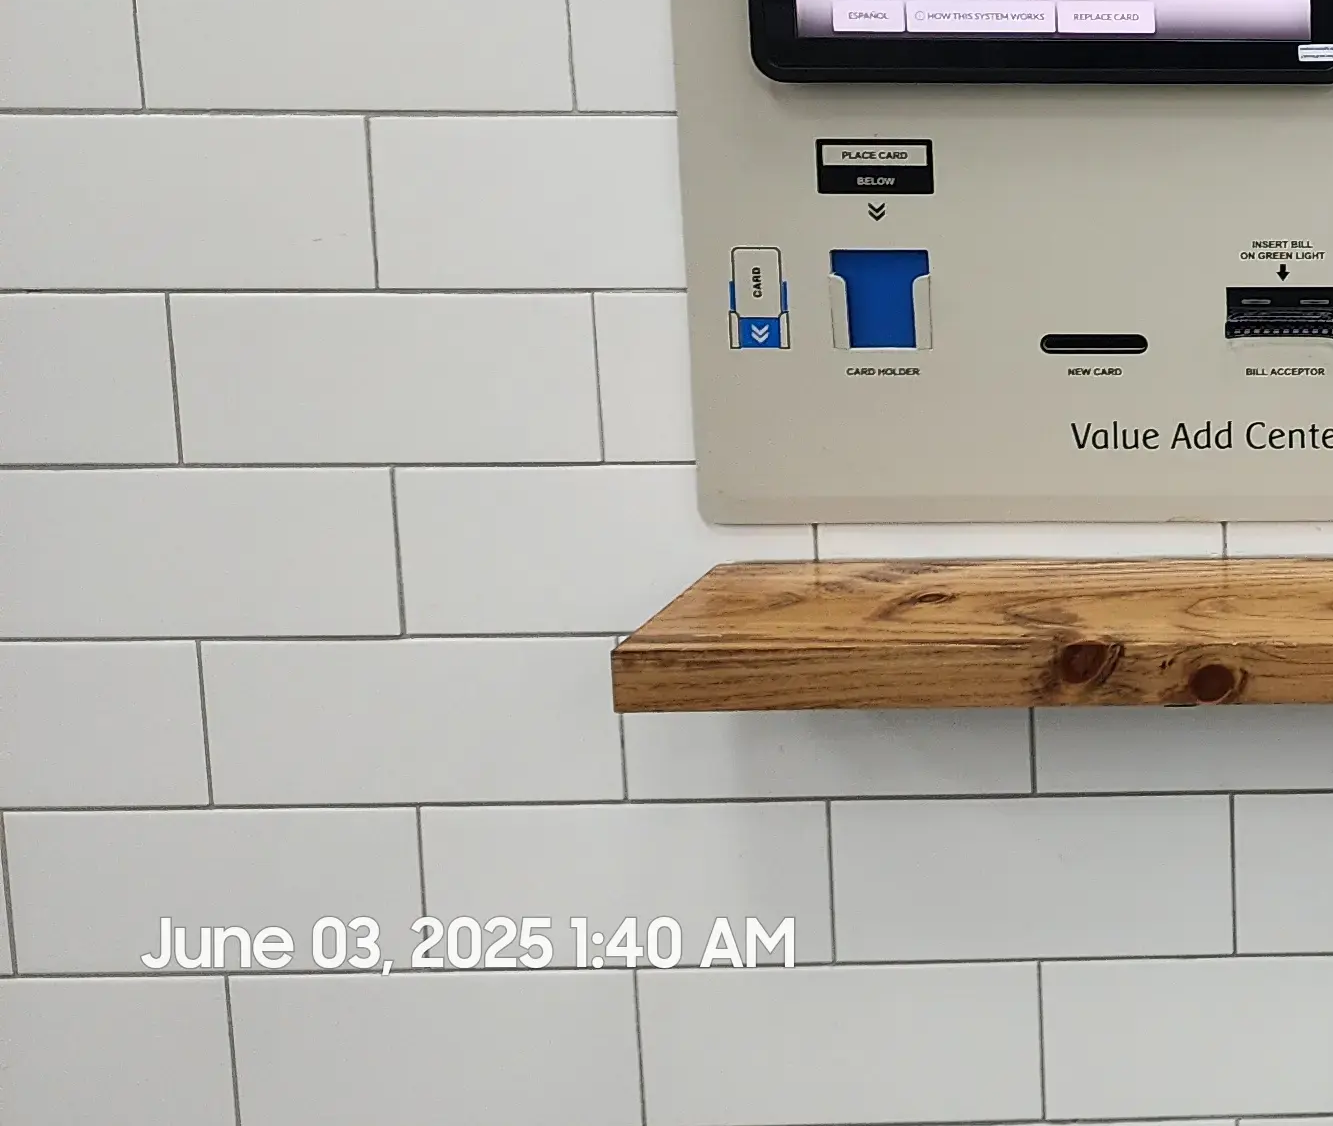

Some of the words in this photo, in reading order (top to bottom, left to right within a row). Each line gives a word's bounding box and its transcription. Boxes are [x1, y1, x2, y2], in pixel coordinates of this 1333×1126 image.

[842, 151, 877, 159] PLACE
[857, 177, 895, 185] BELOW
[752, 267, 762, 298] CARD
[1071, 421, 1159, 449] Value
[1171, 421, 1232, 449] Add
